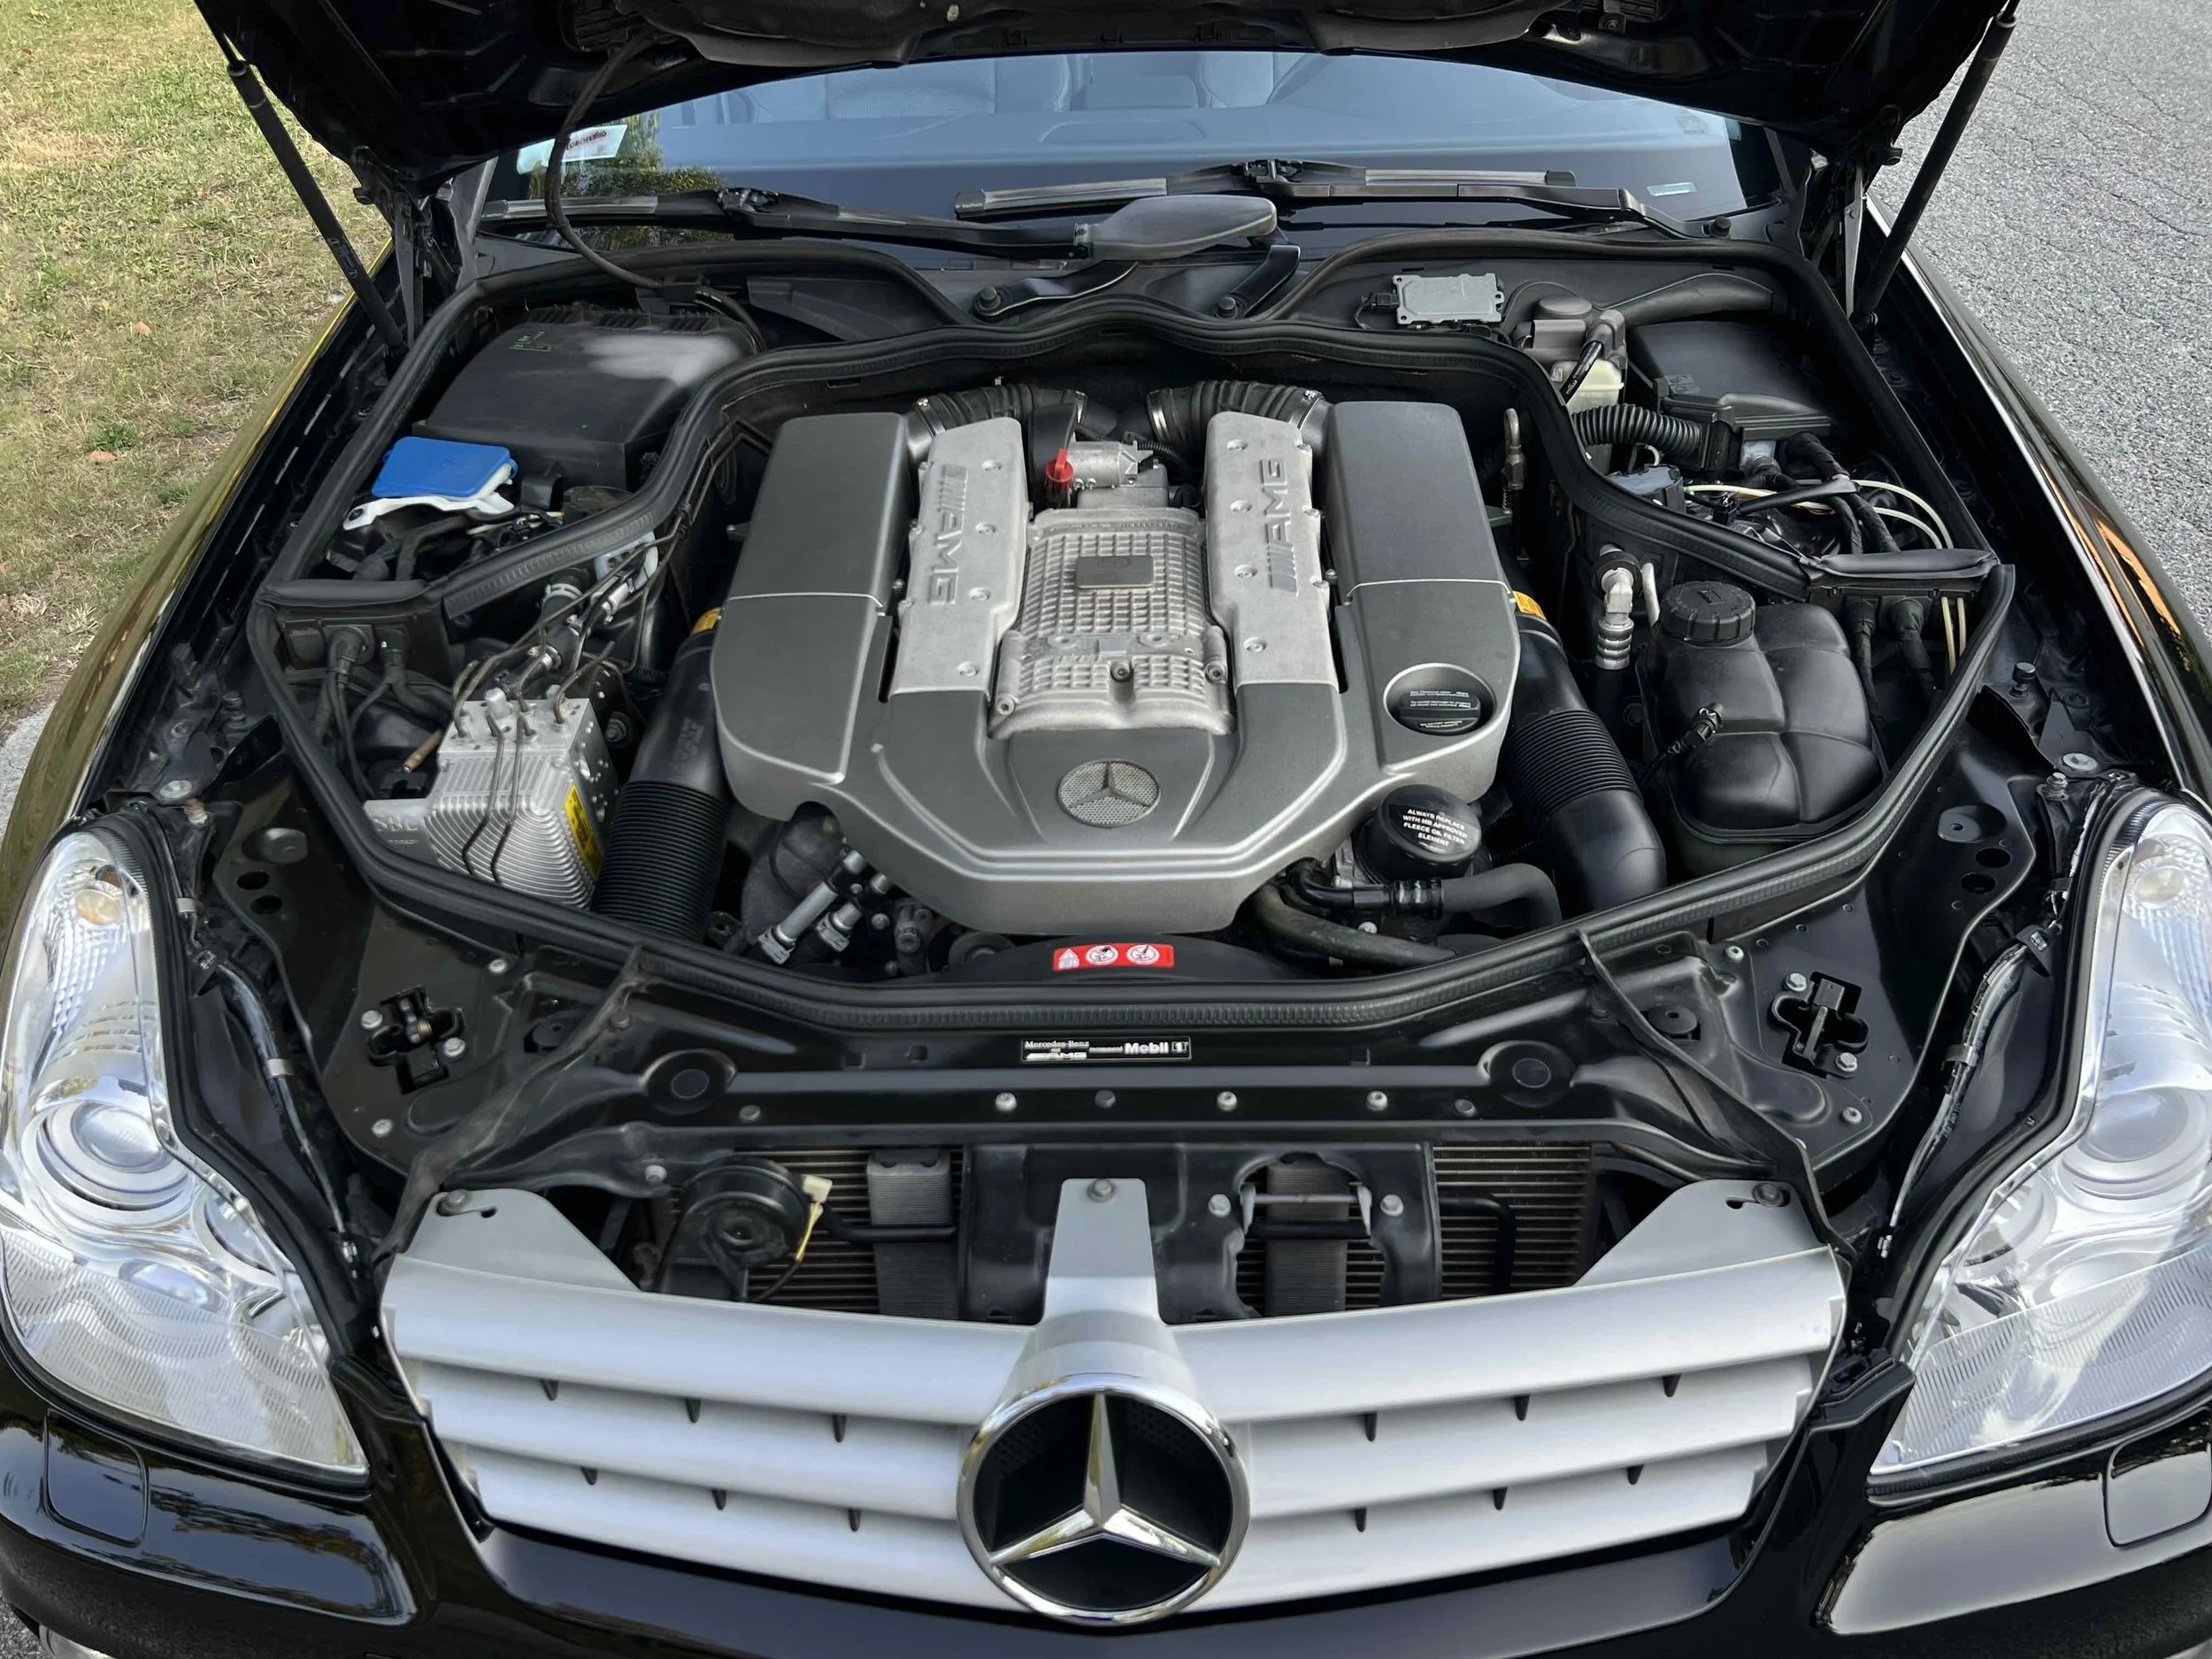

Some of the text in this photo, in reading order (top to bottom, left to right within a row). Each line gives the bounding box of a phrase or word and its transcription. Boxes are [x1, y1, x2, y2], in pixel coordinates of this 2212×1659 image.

[1260, 458, 1292, 543] AMG
[928, 511, 964, 605] AMG
[1407, 809, 1465, 831] ALWAYS REPLACE
[1433, 821, 1468, 839] APPROVED
[1403, 822, 1465, 845] FLEECE OIL FILTER
[1417, 832, 1449, 847] ELEMENT
[1125, 1042, 1170, 1054] Mobil
